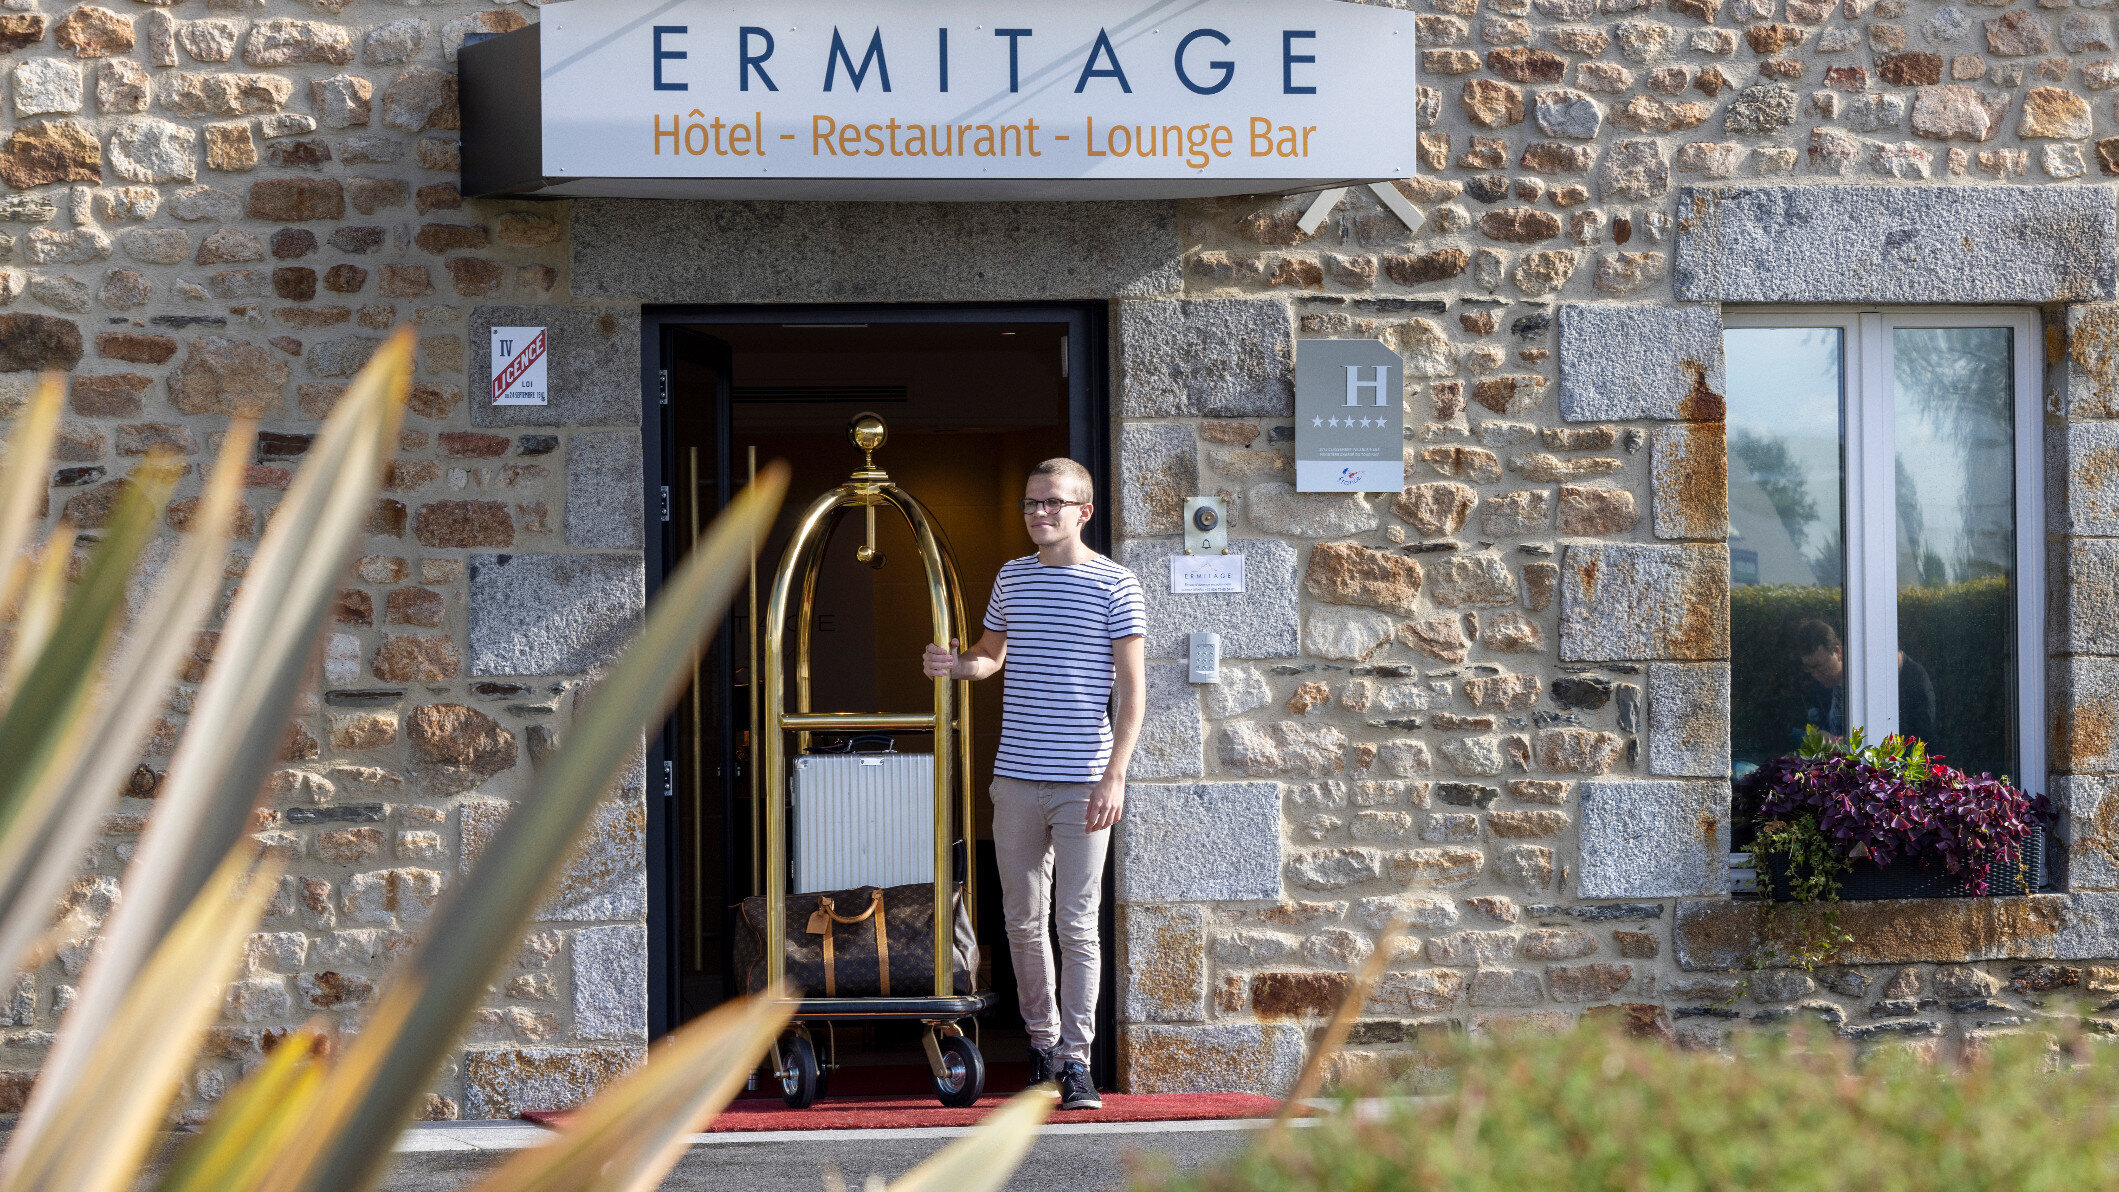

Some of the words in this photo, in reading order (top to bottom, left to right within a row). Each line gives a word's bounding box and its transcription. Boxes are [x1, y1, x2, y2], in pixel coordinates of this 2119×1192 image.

[653, 25, 1317, 96] ERMITAGE
[653, 108, 766, 157] Hôtel
[812, 114, 1042, 157] Restaurant
[1086, 116, 1233, 170] Lounge
[1249, 116, 1317, 158] Bar
[494, 334, 544, 398] LICENCE
[500, 340, 513, 357] IV
[1341, 365, 1392, 406] H
